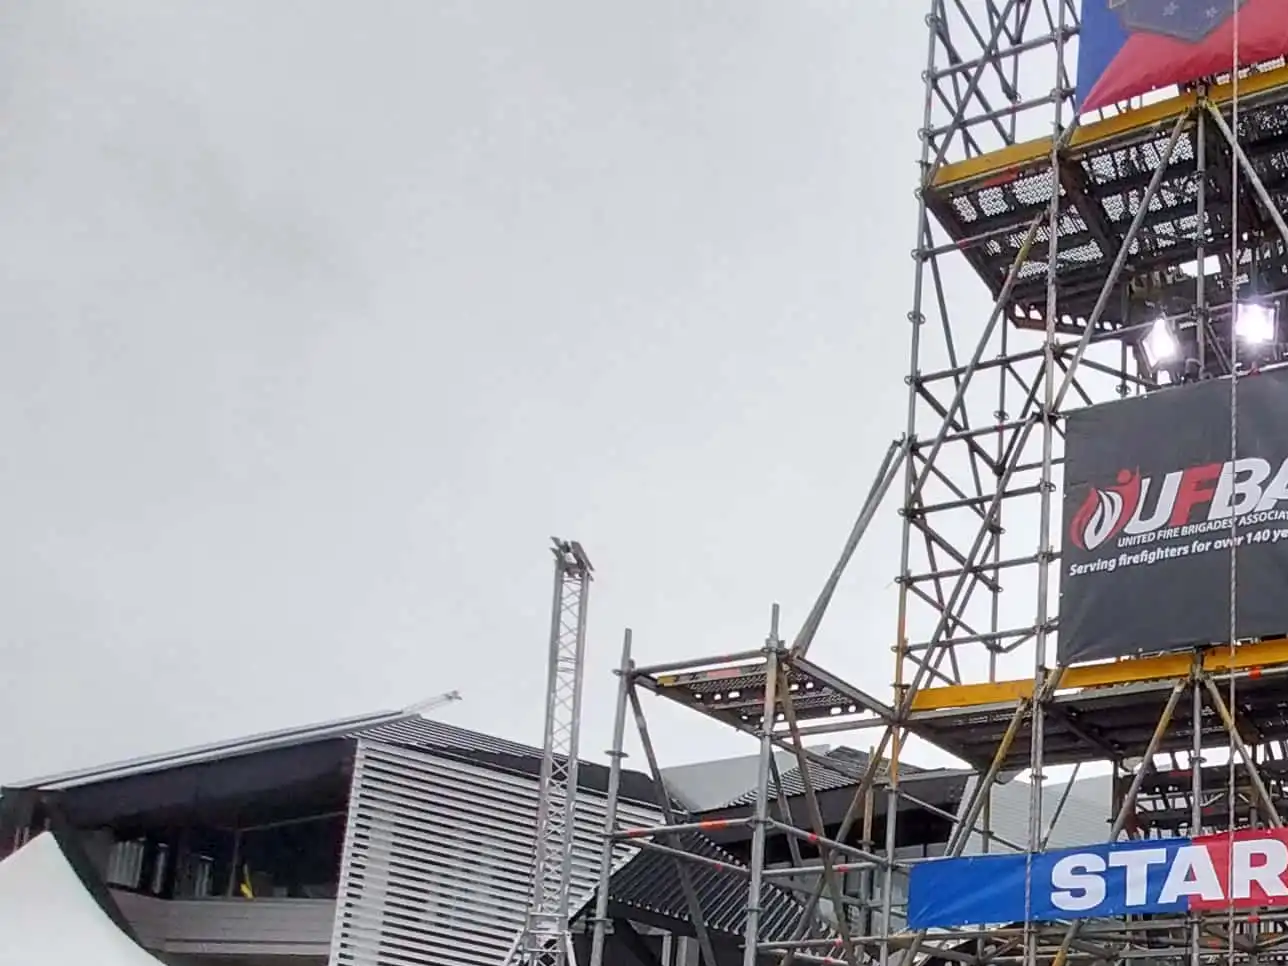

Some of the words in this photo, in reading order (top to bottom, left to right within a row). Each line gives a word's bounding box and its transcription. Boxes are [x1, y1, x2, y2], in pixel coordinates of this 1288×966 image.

[1069, 558, 1117, 577] Serving
[1118, 544, 1189, 567] firefighters
[1191, 540, 1212, 553] for
[1246, 528, 1271, 544] 140
[1117, 533, 1156, 548] UNITED
[1156, 527, 1180, 541] FIRE
